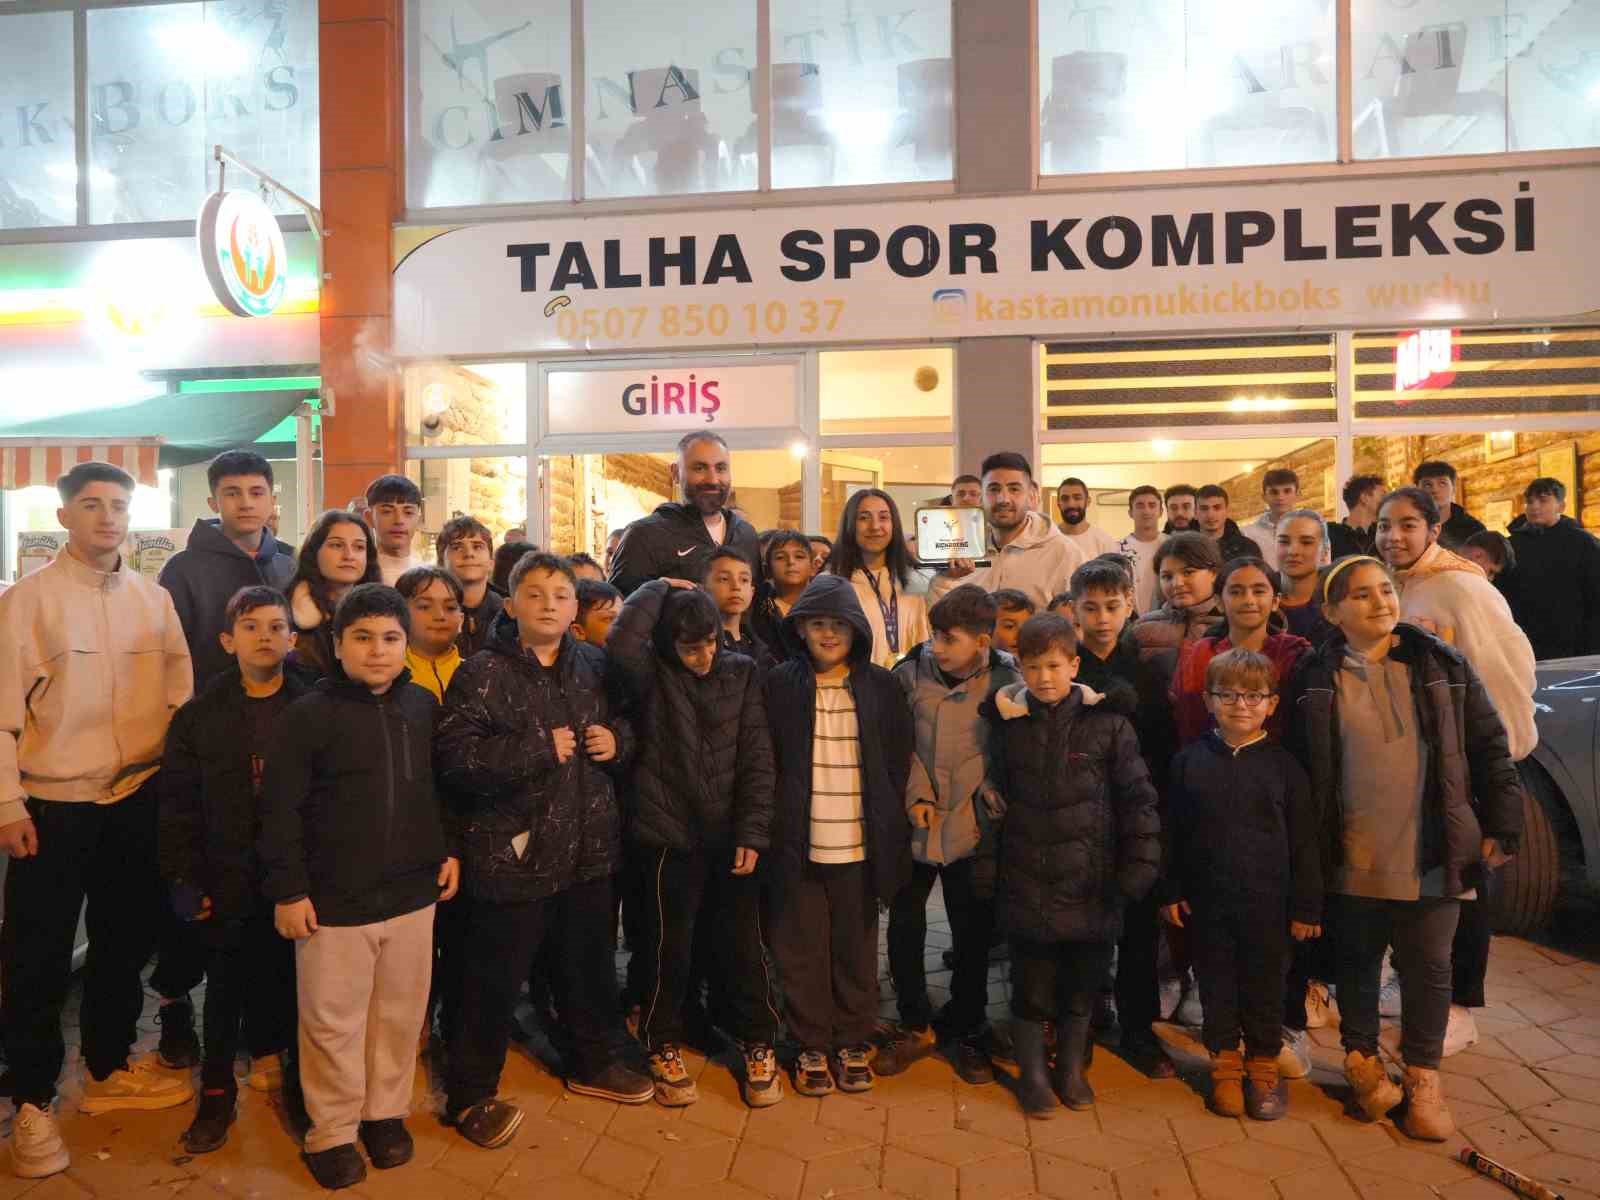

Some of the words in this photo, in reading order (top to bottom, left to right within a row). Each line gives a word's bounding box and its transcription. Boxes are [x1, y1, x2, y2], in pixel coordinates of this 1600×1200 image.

[507, 234, 752, 292] TALHA
[780, 223, 998, 282] SPOR
[1031, 181, 1535, 272] KOMPLEKSİ
[556, 307, 648, 340] 0507
[658, 303, 731, 337] 850
[743, 300, 788, 336] 10
[799, 297, 846, 333] 37
[976, 281, 1341, 321] kastamonukickboks
[622, 374, 721, 422] GİRİŞ
